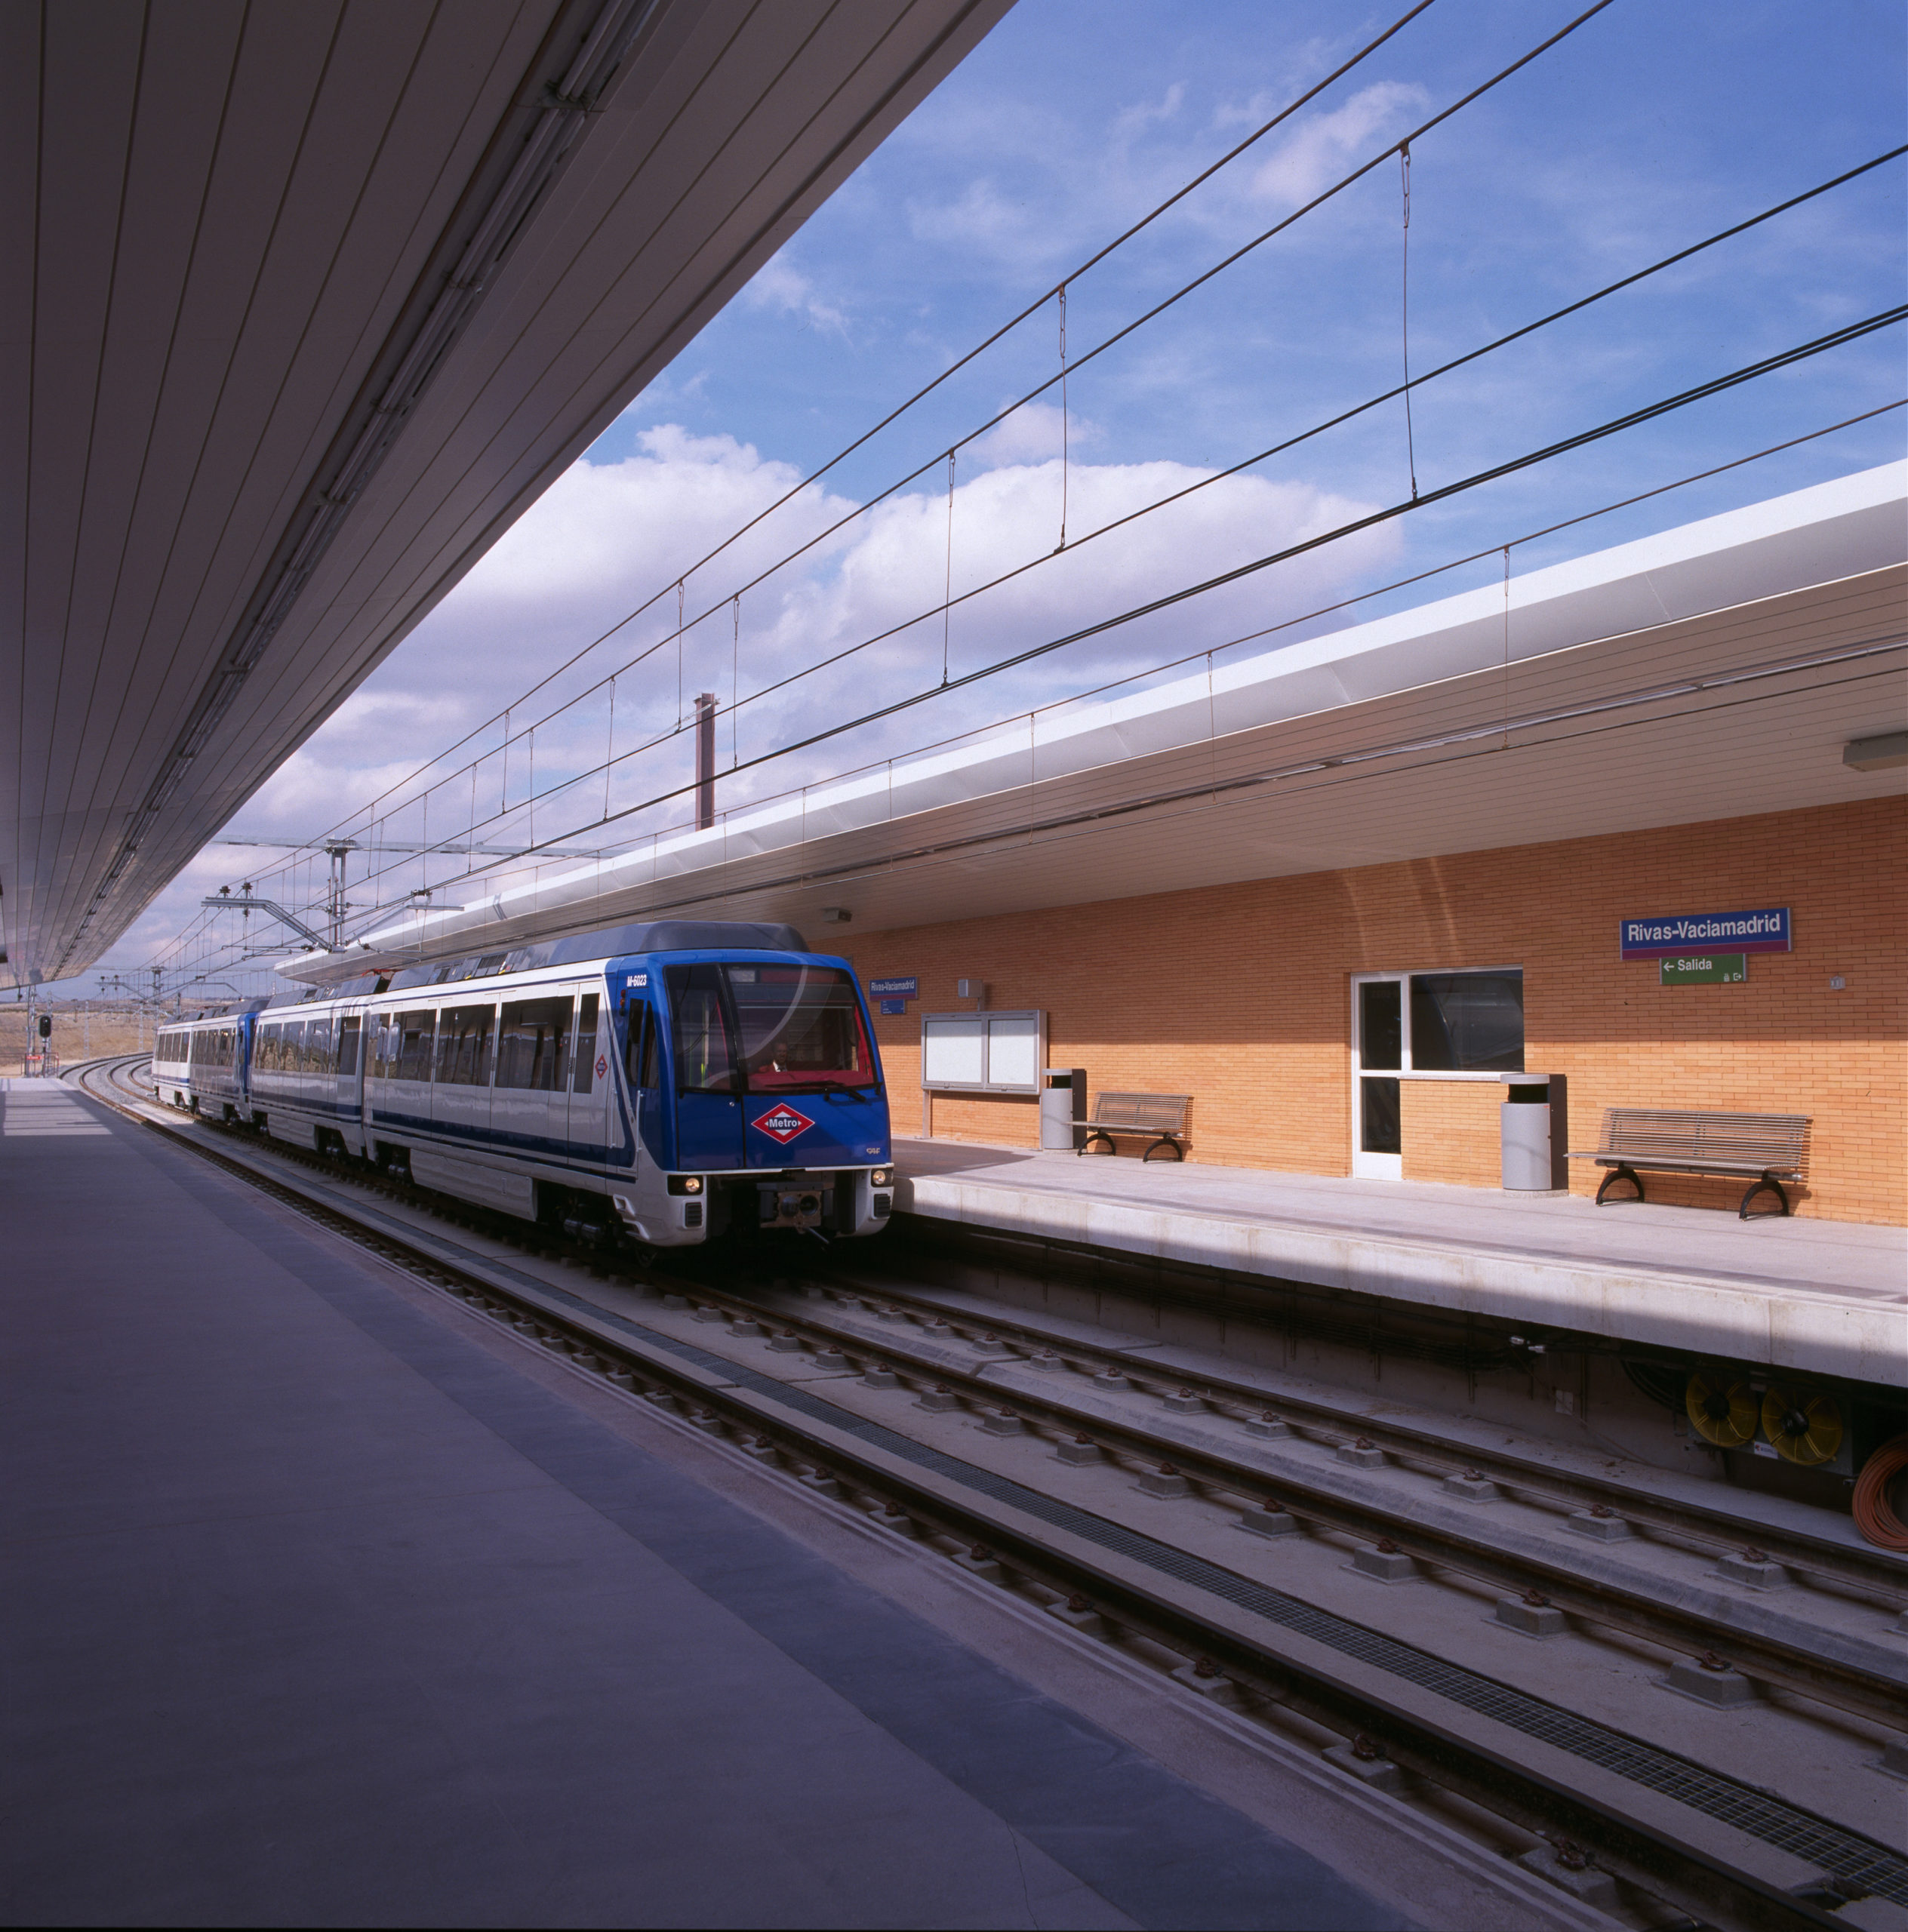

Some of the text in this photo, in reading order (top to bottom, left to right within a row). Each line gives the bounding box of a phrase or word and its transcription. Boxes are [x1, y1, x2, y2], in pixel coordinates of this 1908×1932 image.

[1628, 913, 1780, 942] Rivas-Vaciamadrid
[1677, 958, 1713, 971] Salida
[627, 974, 647, 987] M-6023
[871, 980, 915, 992] Rivas-Vaciamadrid
[768, 1118, 798, 1128] Metro
